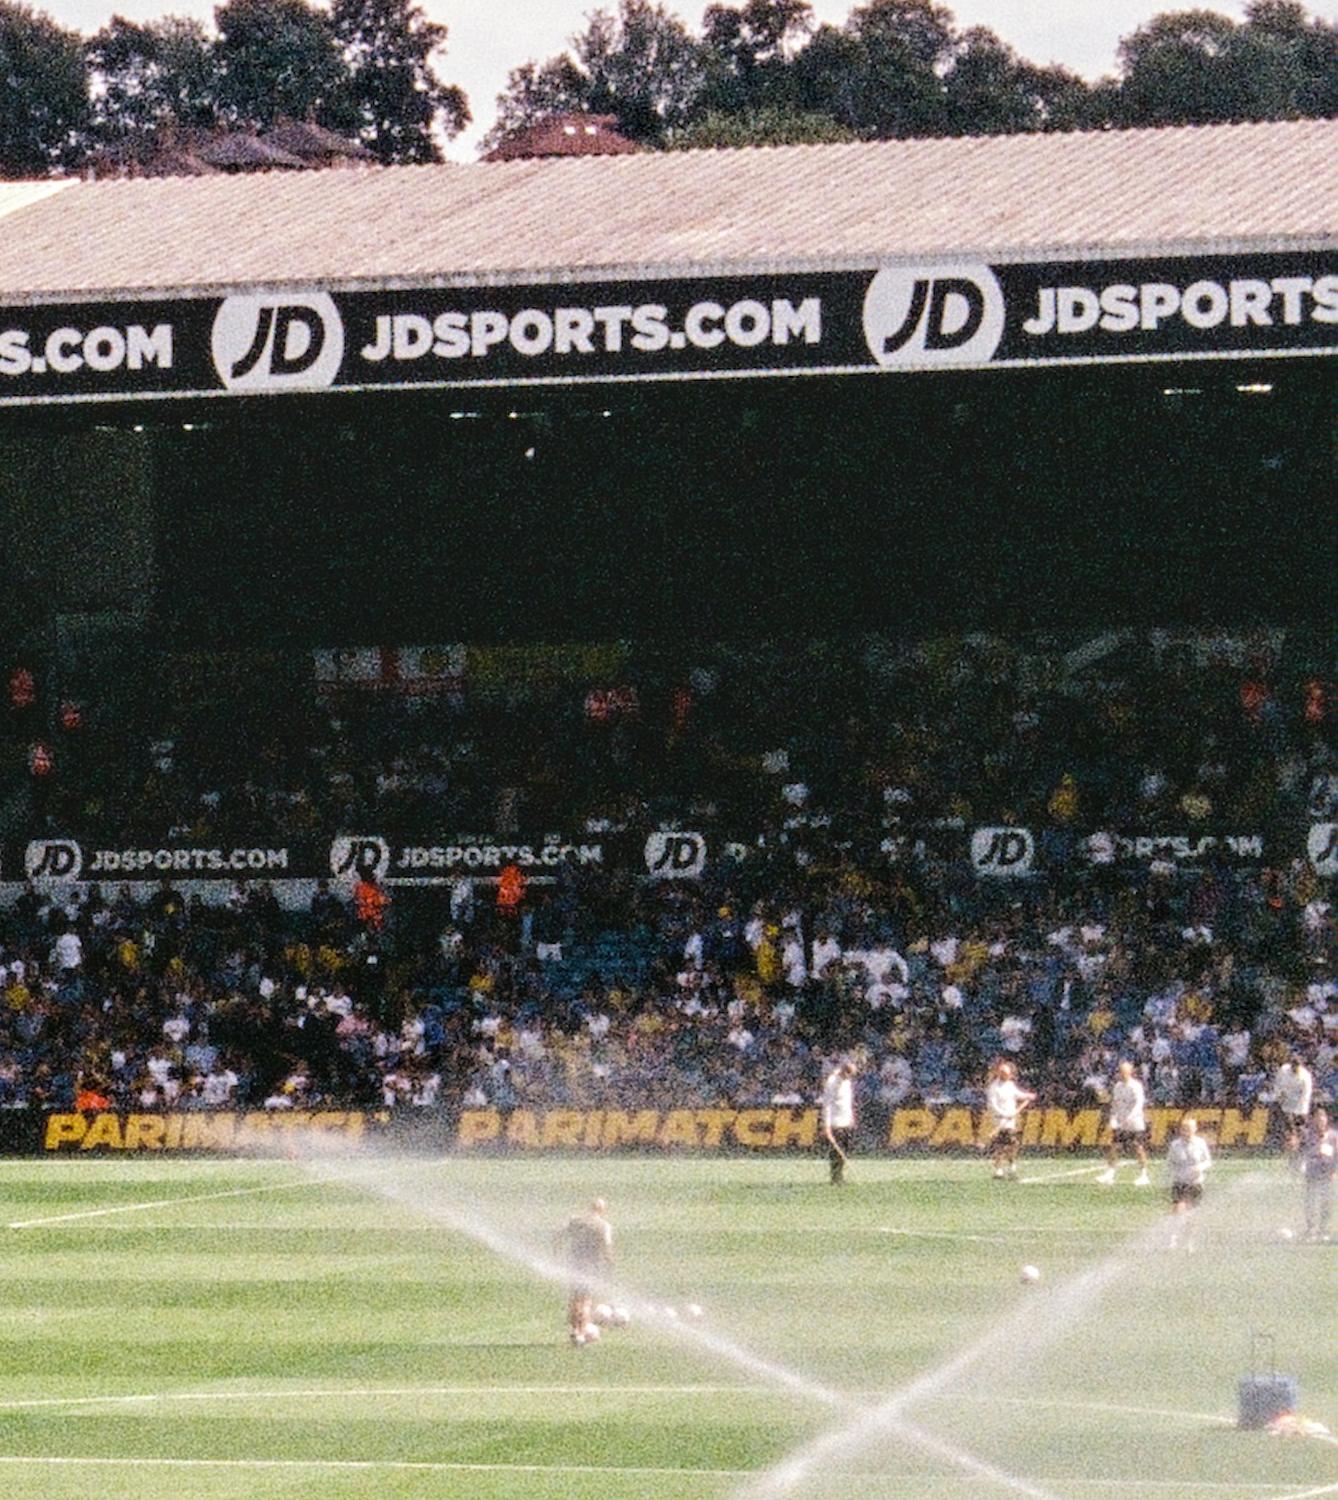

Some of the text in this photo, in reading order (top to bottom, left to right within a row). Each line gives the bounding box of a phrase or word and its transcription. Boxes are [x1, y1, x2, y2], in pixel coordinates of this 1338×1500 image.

[361, 298, 821, 361] JDSPORTS.COM
[90, 846, 288, 872] JDSPORTS.COM
[458, 1109, 818, 1147] PARIMATCH
